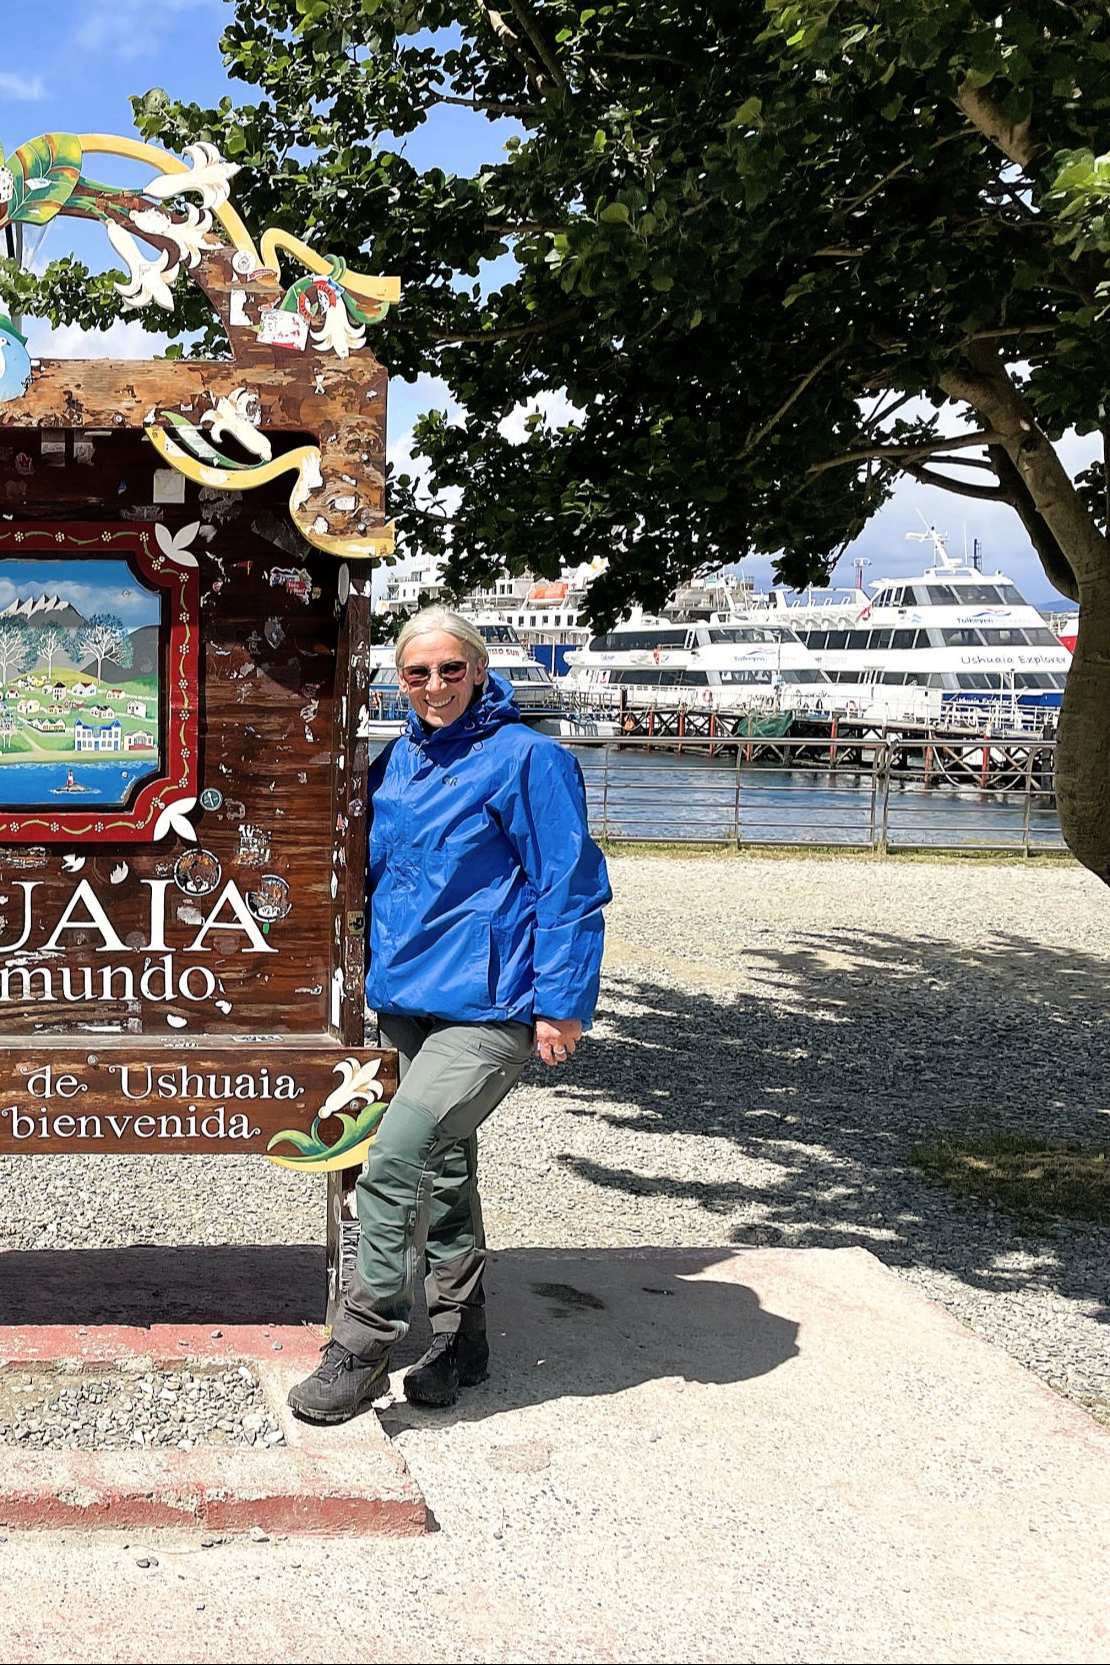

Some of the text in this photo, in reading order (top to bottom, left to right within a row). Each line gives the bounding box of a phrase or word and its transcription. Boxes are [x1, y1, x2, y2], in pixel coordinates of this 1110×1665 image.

[960, 654, 1066, 666] Ushuaia Explorer
[19, 1064, 89, 1100] de
[108, 1064, 305, 1100] Ushuaia
[1, 1104, 262, 1140] bienvenida
